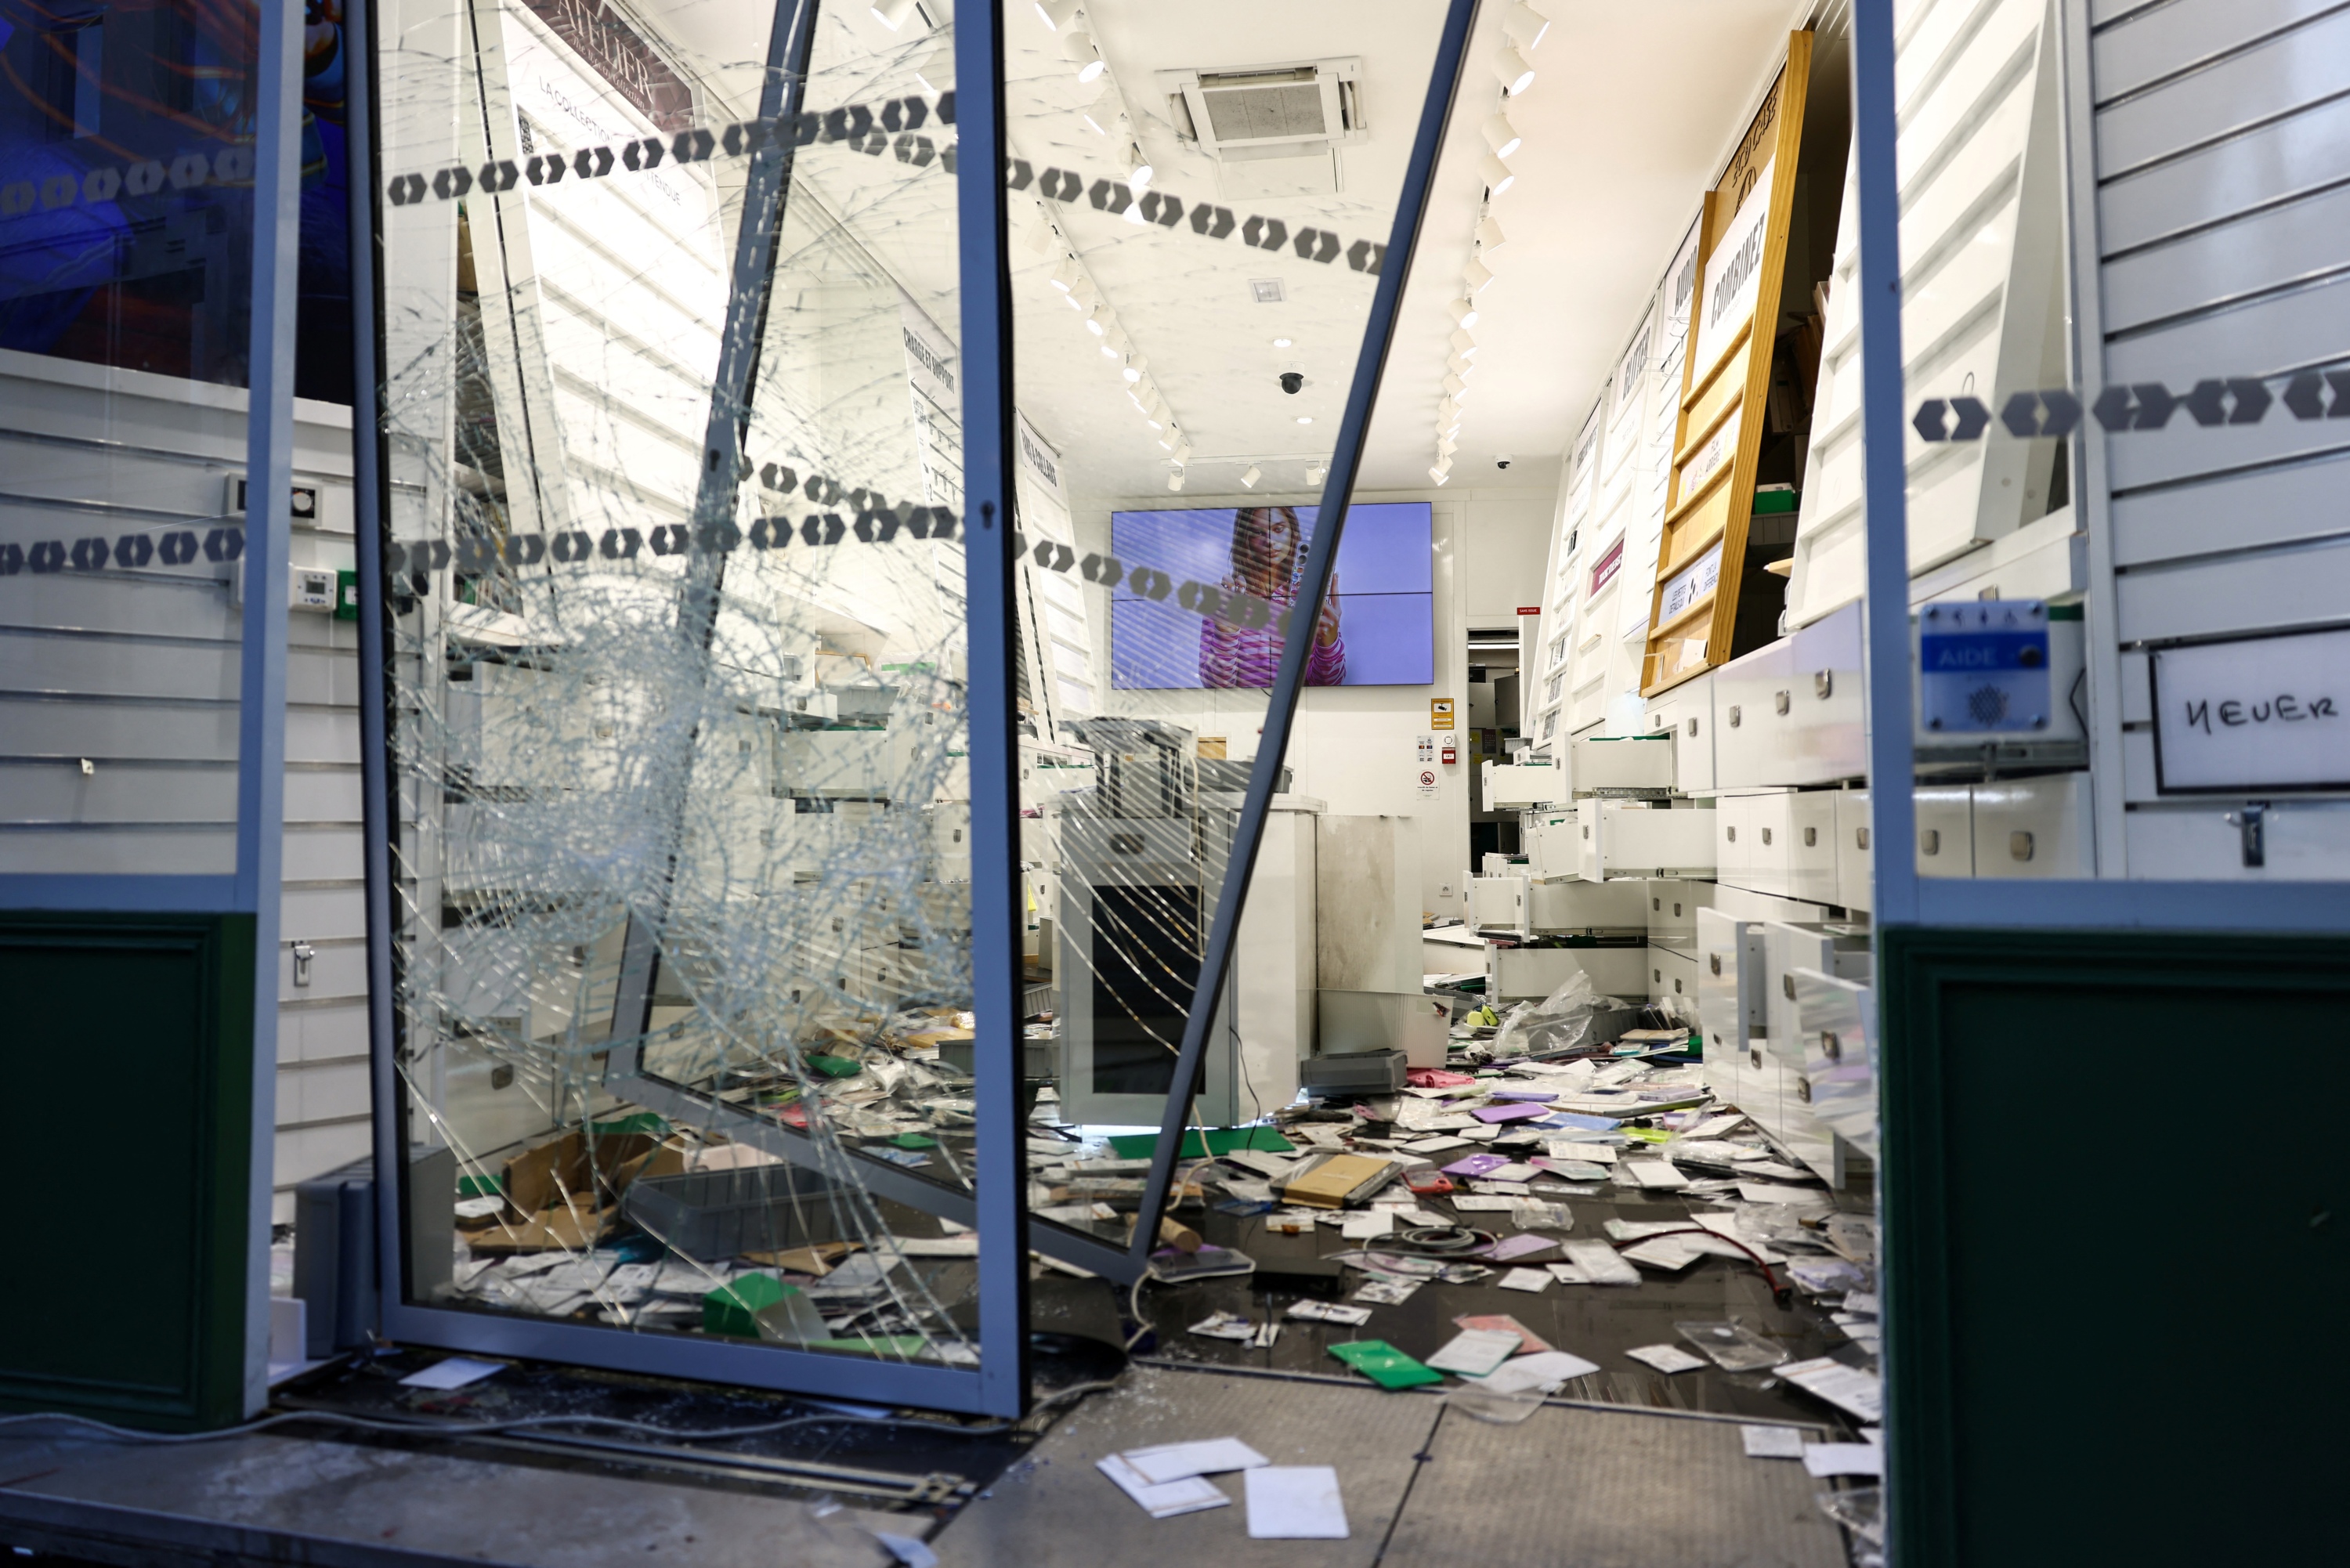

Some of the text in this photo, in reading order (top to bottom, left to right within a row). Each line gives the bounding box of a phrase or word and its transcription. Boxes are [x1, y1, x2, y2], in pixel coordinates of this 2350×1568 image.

[538, 75, 554, 101] LA
[557, 0, 653, 104] ATELIER
[572, 33, 645, 111] The Woven Collection
[1732, 85, 1779, 189] ECO CASE
[1674, 244, 1697, 316] AUDIO
[1711, 211, 1766, 330] COMBINEZ
[903, 326, 926, 367] CHARGE
[925, 348, 932, 372] ET
[932, 355, 955, 395] SUPPORT
[1938, 647, 1998, 667] AIDE
